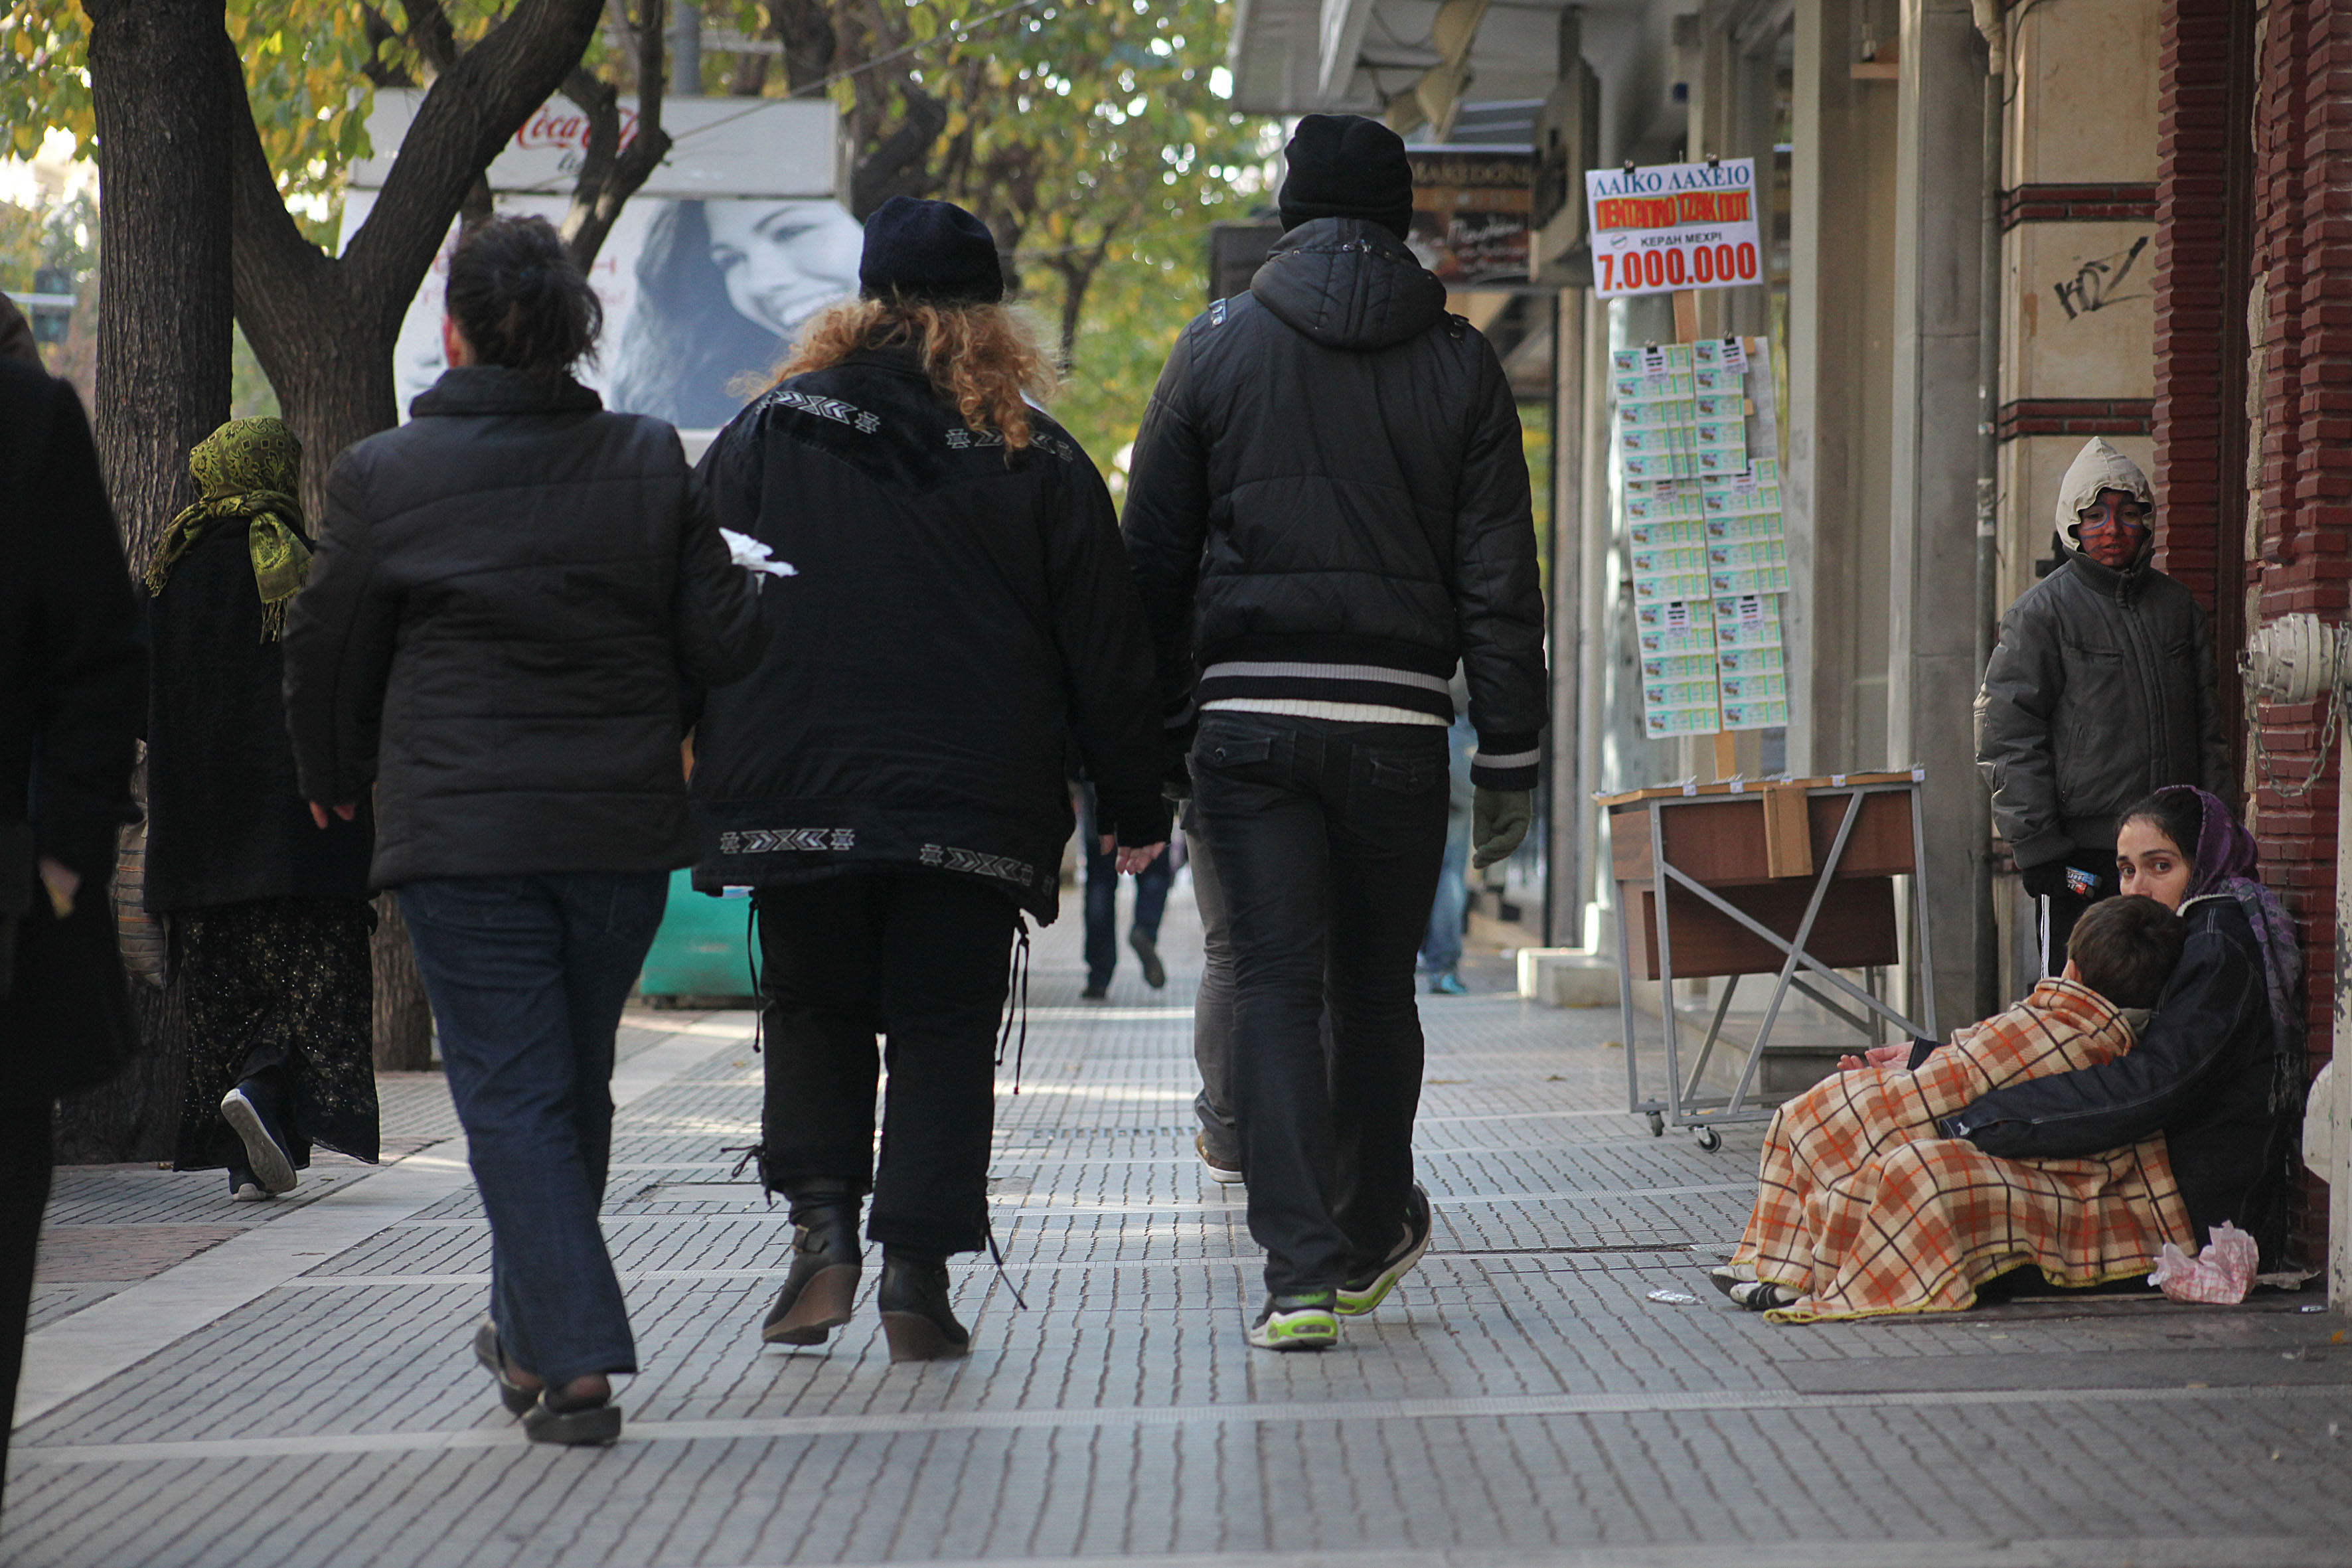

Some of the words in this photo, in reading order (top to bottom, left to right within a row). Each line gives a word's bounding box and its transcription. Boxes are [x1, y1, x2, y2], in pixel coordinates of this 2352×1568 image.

[1668, 165, 1750, 190] ΛΑΧΕΙΟ
[1640, 234, 1682, 247] ΚΕΡΔΗ
[1685, 232, 1722, 244] ΜΕΧΡΙ
[1599, 242, 1757, 291] 7.000.000
